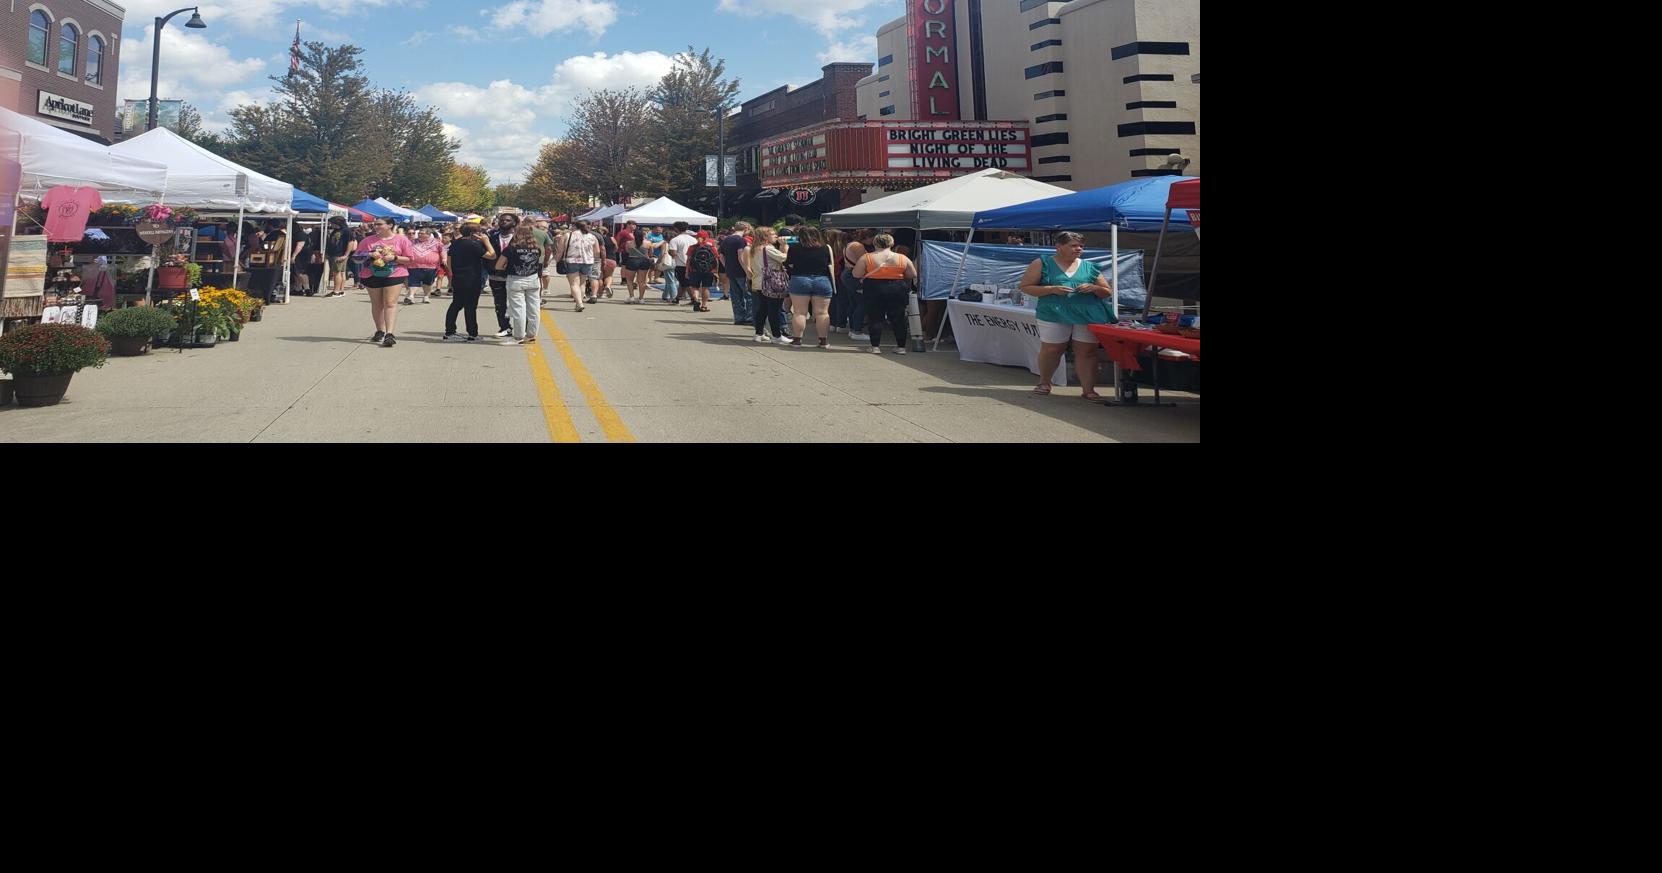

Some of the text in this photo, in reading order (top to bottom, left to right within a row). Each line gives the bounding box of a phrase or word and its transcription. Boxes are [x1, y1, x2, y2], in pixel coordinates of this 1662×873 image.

[44, 96, 94, 117] Apricot Lane
[889, 129, 1018, 140] BRIGHT GREEN LIES
[910, 143, 1008, 154] NIGHT OF THE
[912, 157, 1008, 168] LIVING DEAD
[964, 313, 985, 327] THE
[983, 314, 1021, 332] ENERGY
